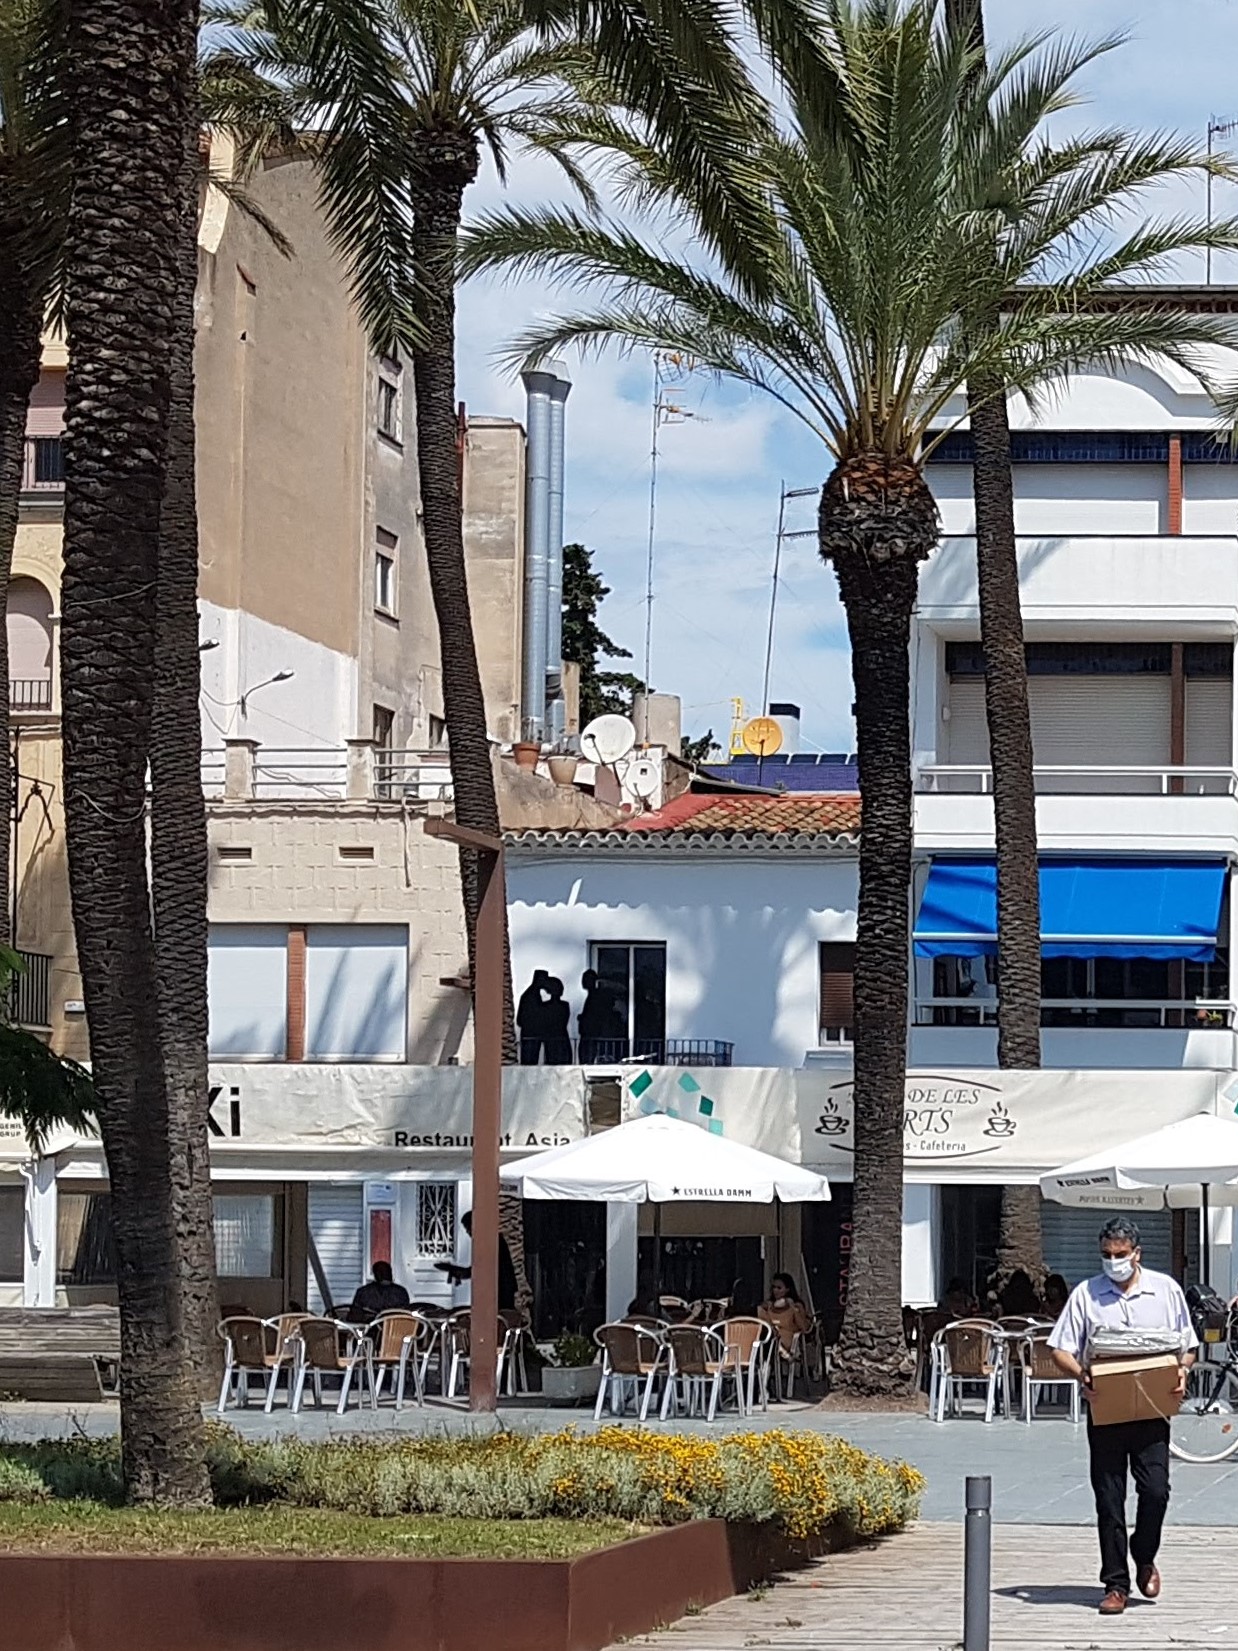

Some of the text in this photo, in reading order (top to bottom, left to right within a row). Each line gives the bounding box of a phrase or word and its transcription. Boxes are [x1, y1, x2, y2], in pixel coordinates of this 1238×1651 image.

[908, 1089, 981, 1105] DE LES
[903, 1107, 954, 1136] RTS
[395, 1131, 512, 1147] Restaut
[683, 1187, 752, 1198] ESTRELLA DAMM
